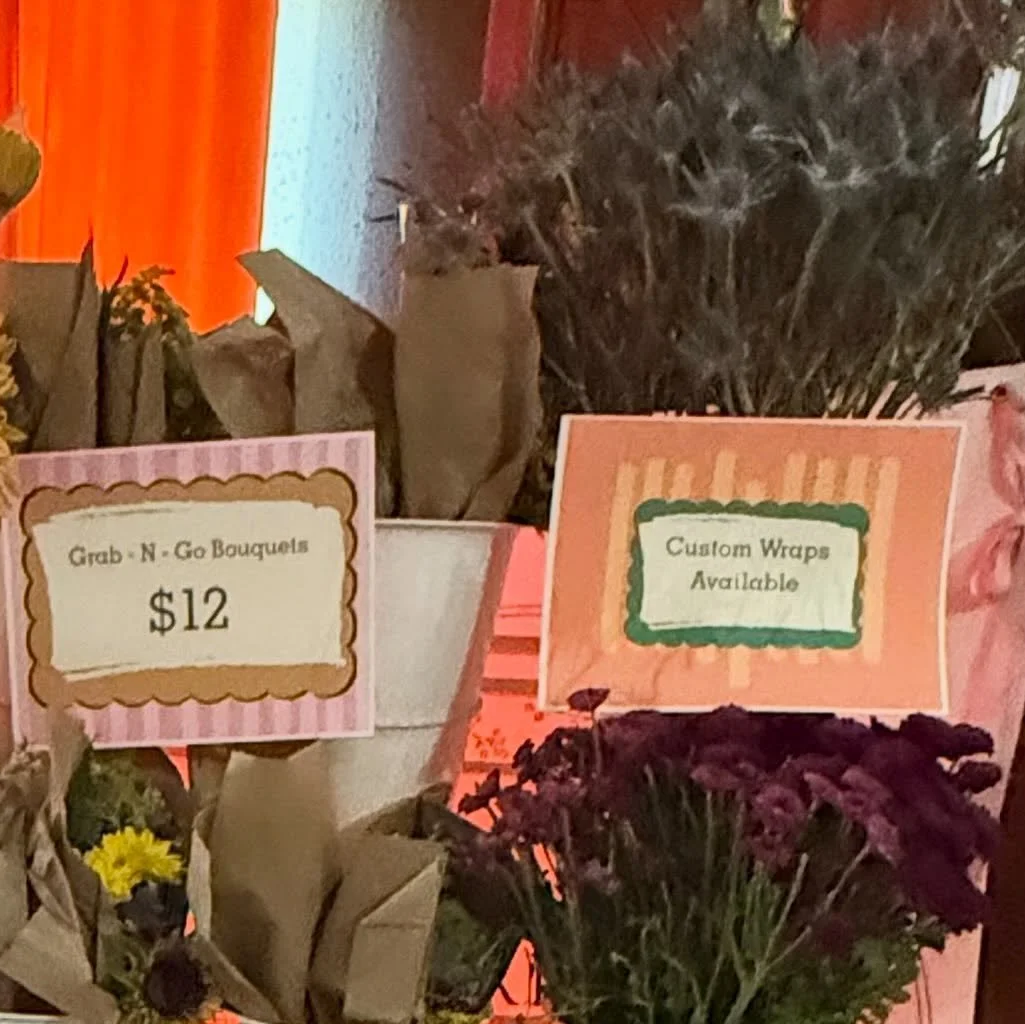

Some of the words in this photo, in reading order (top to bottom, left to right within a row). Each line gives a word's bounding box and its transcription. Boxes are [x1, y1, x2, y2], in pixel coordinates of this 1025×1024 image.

[68, 545, 123, 566] Grab
[140, 543, 156, 562] N
[174, 540, 206, 560] Go
[211, 537, 309, 560] Bouquets
[665, 536, 752, 558] Custom
[760, 538, 830, 564] Wraps
[690, 570, 800, 593] Available
[149, 586, 229, 636] $12
